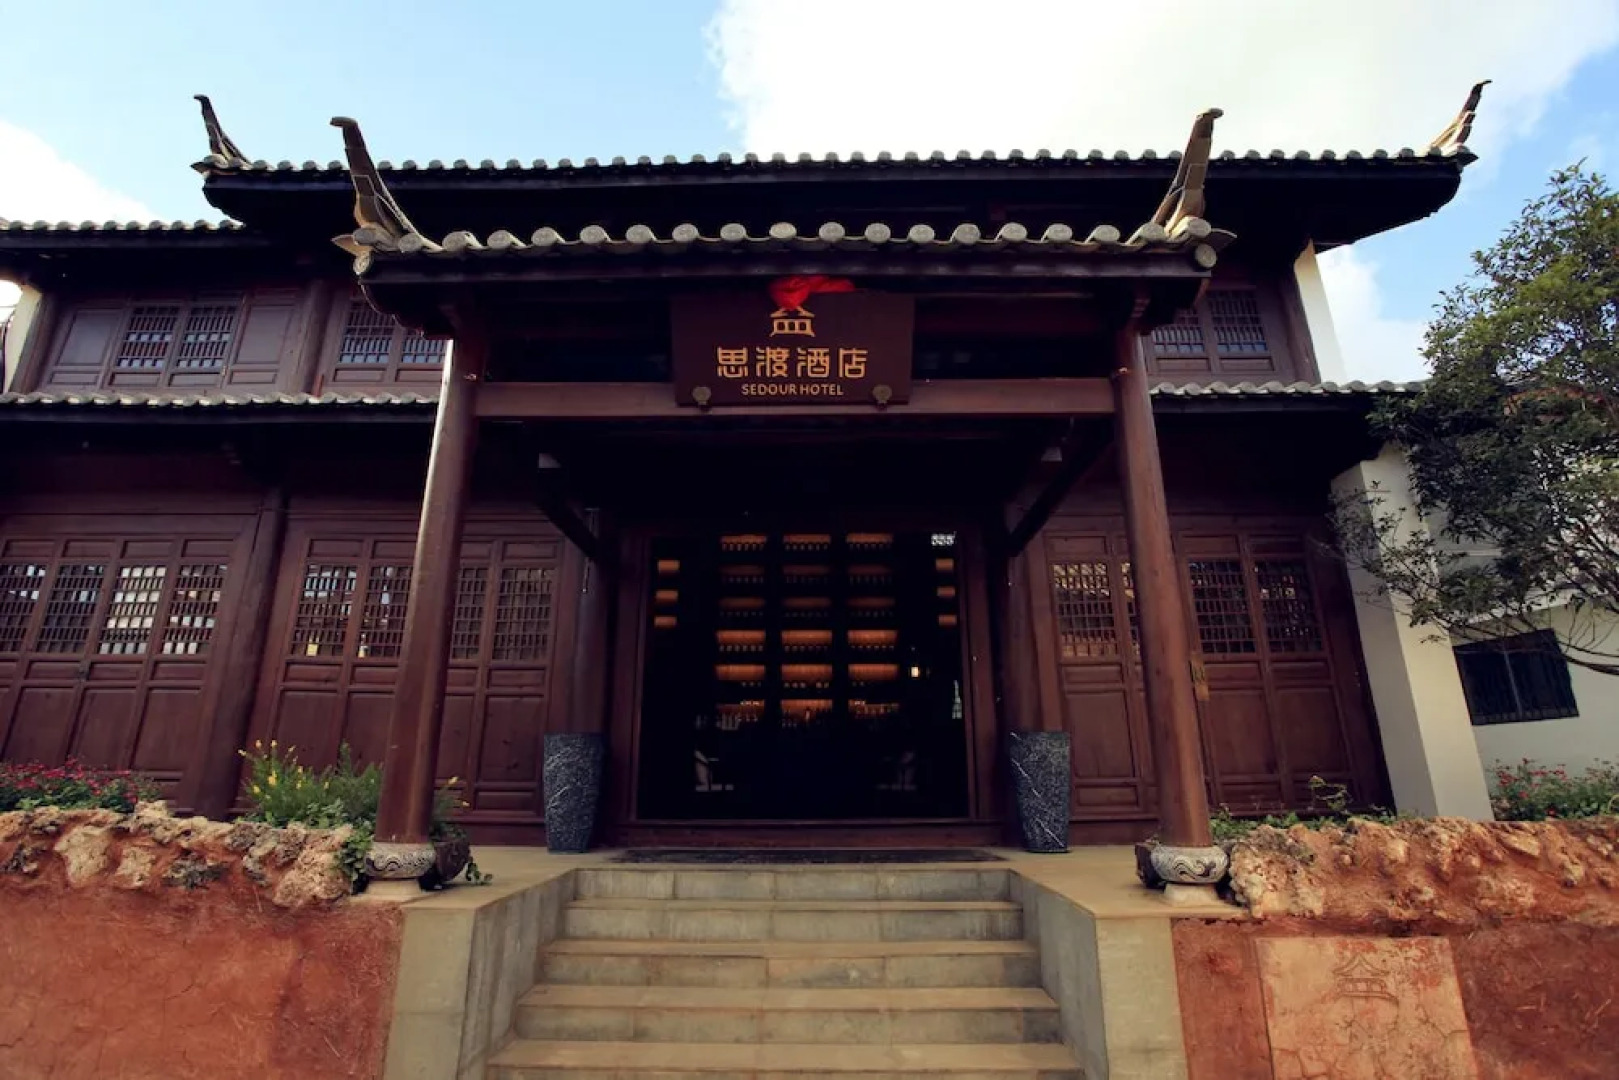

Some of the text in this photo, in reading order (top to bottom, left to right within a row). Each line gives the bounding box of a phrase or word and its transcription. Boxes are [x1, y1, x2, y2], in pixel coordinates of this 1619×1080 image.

[717, 346, 868, 378] 思渡酒店
[741, 383, 844, 396] SEDOUR HOTEL
